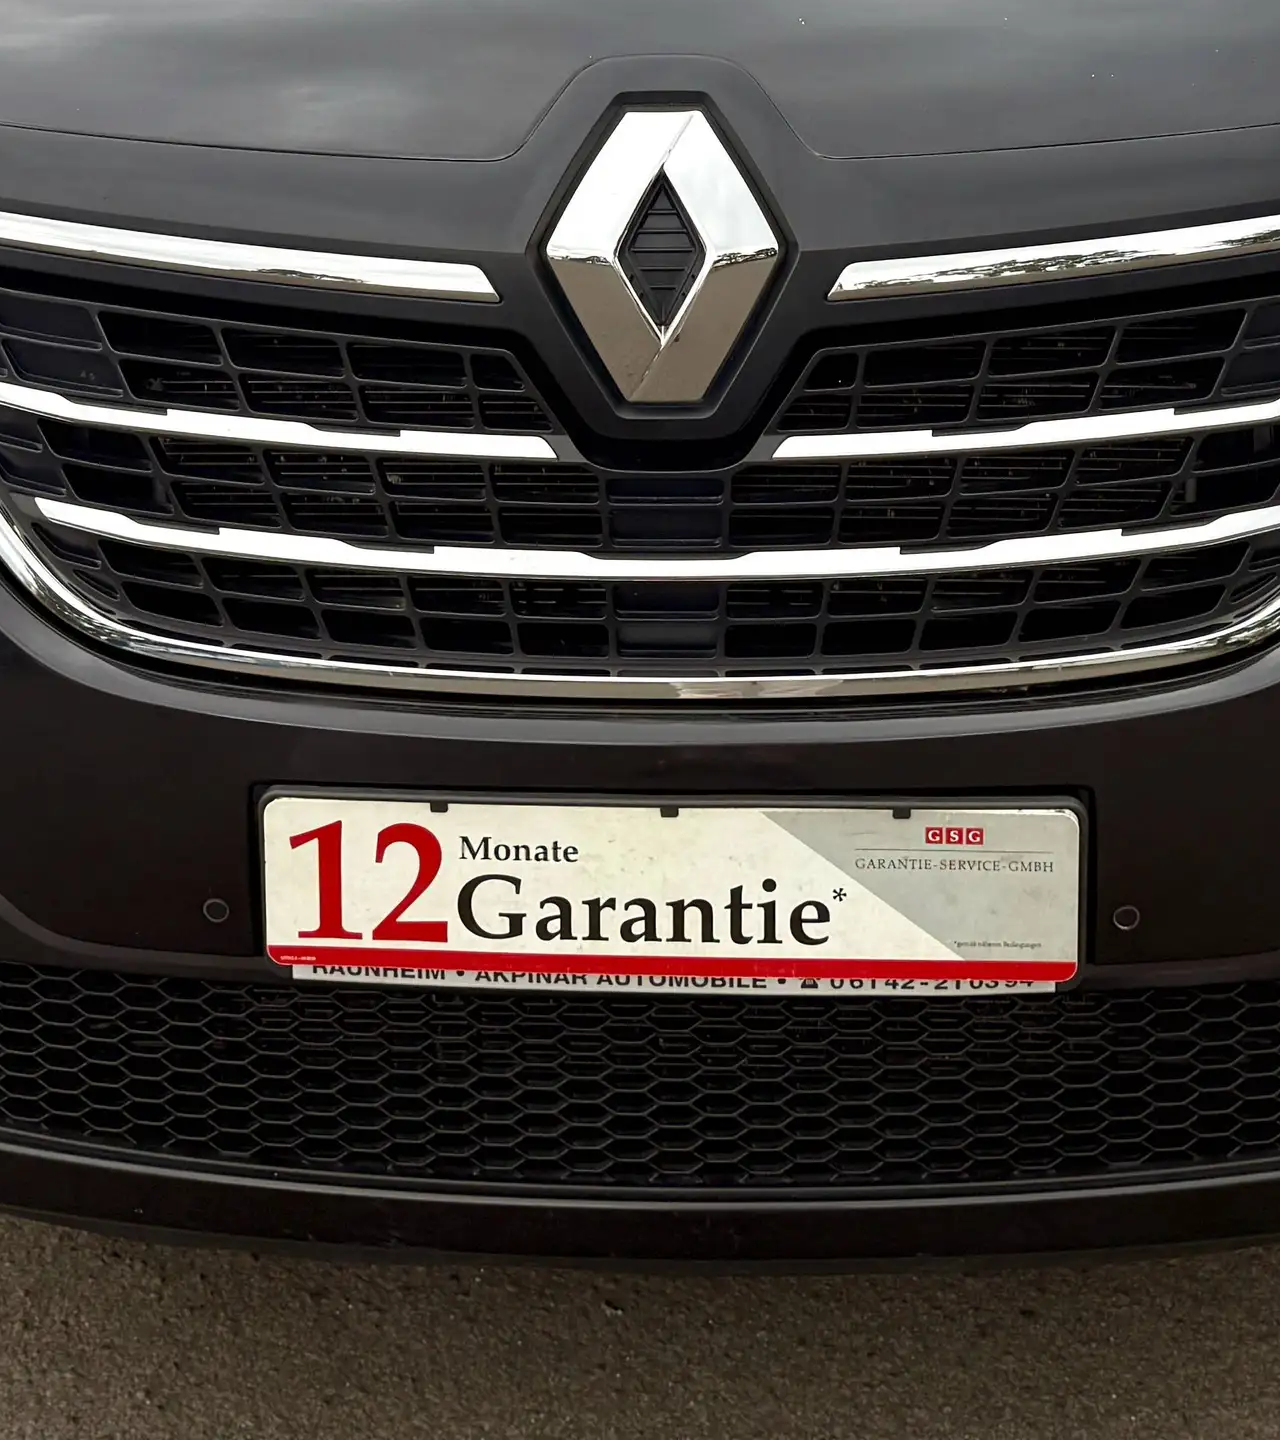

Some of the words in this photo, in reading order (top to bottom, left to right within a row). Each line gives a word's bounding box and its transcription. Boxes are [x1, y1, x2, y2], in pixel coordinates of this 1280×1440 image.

[926, 828, 983, 844] GSG
[459, 835, 579, 863] Monate
[855, 858, 1055, 873] GARANTIE-SERVICE-GMBH
[289, 819, 448, 942] 12
